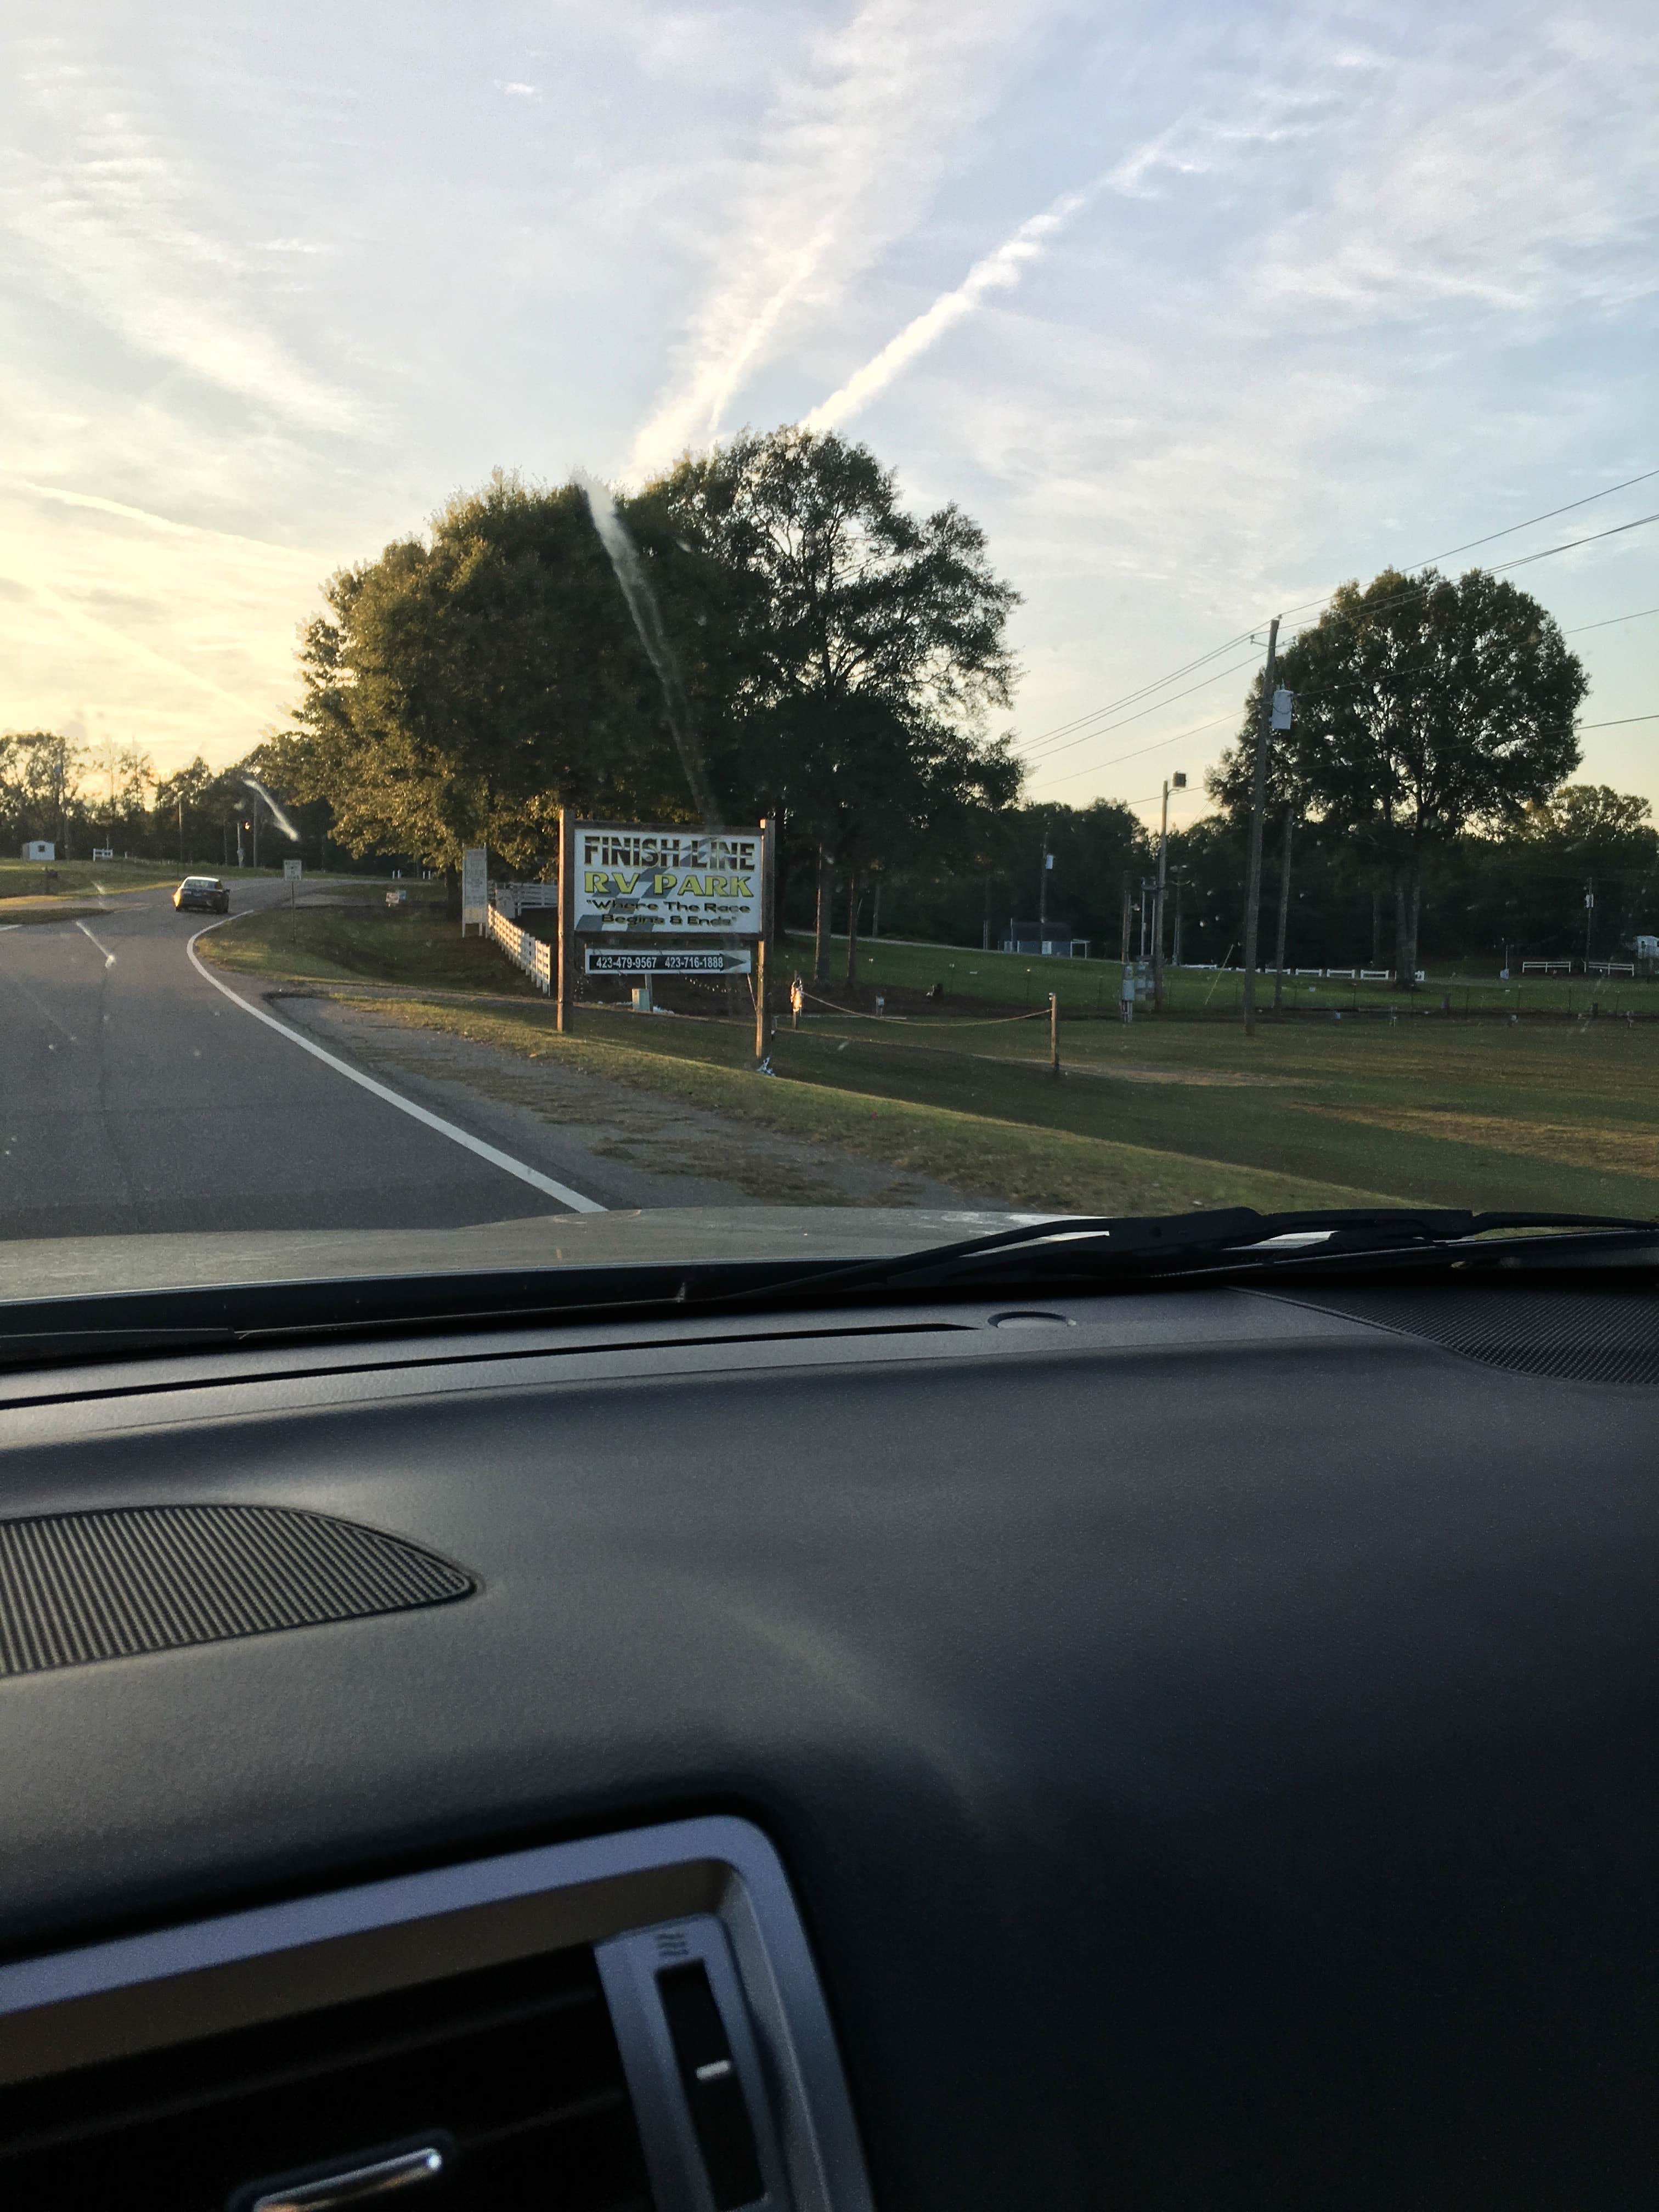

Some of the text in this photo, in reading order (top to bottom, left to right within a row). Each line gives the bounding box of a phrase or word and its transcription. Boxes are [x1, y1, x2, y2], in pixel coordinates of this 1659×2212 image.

[584, 836, 755, 871] FINISH LINE
[584, 871, 754, 897] RV PARK
[663, 901, 700, 912] The
[704, 902, 751, 913] Race
[601, 914, 737, 927] Begins & Ends"
[596, 956, 724, 969] 423-479-9567 423-716-1888
